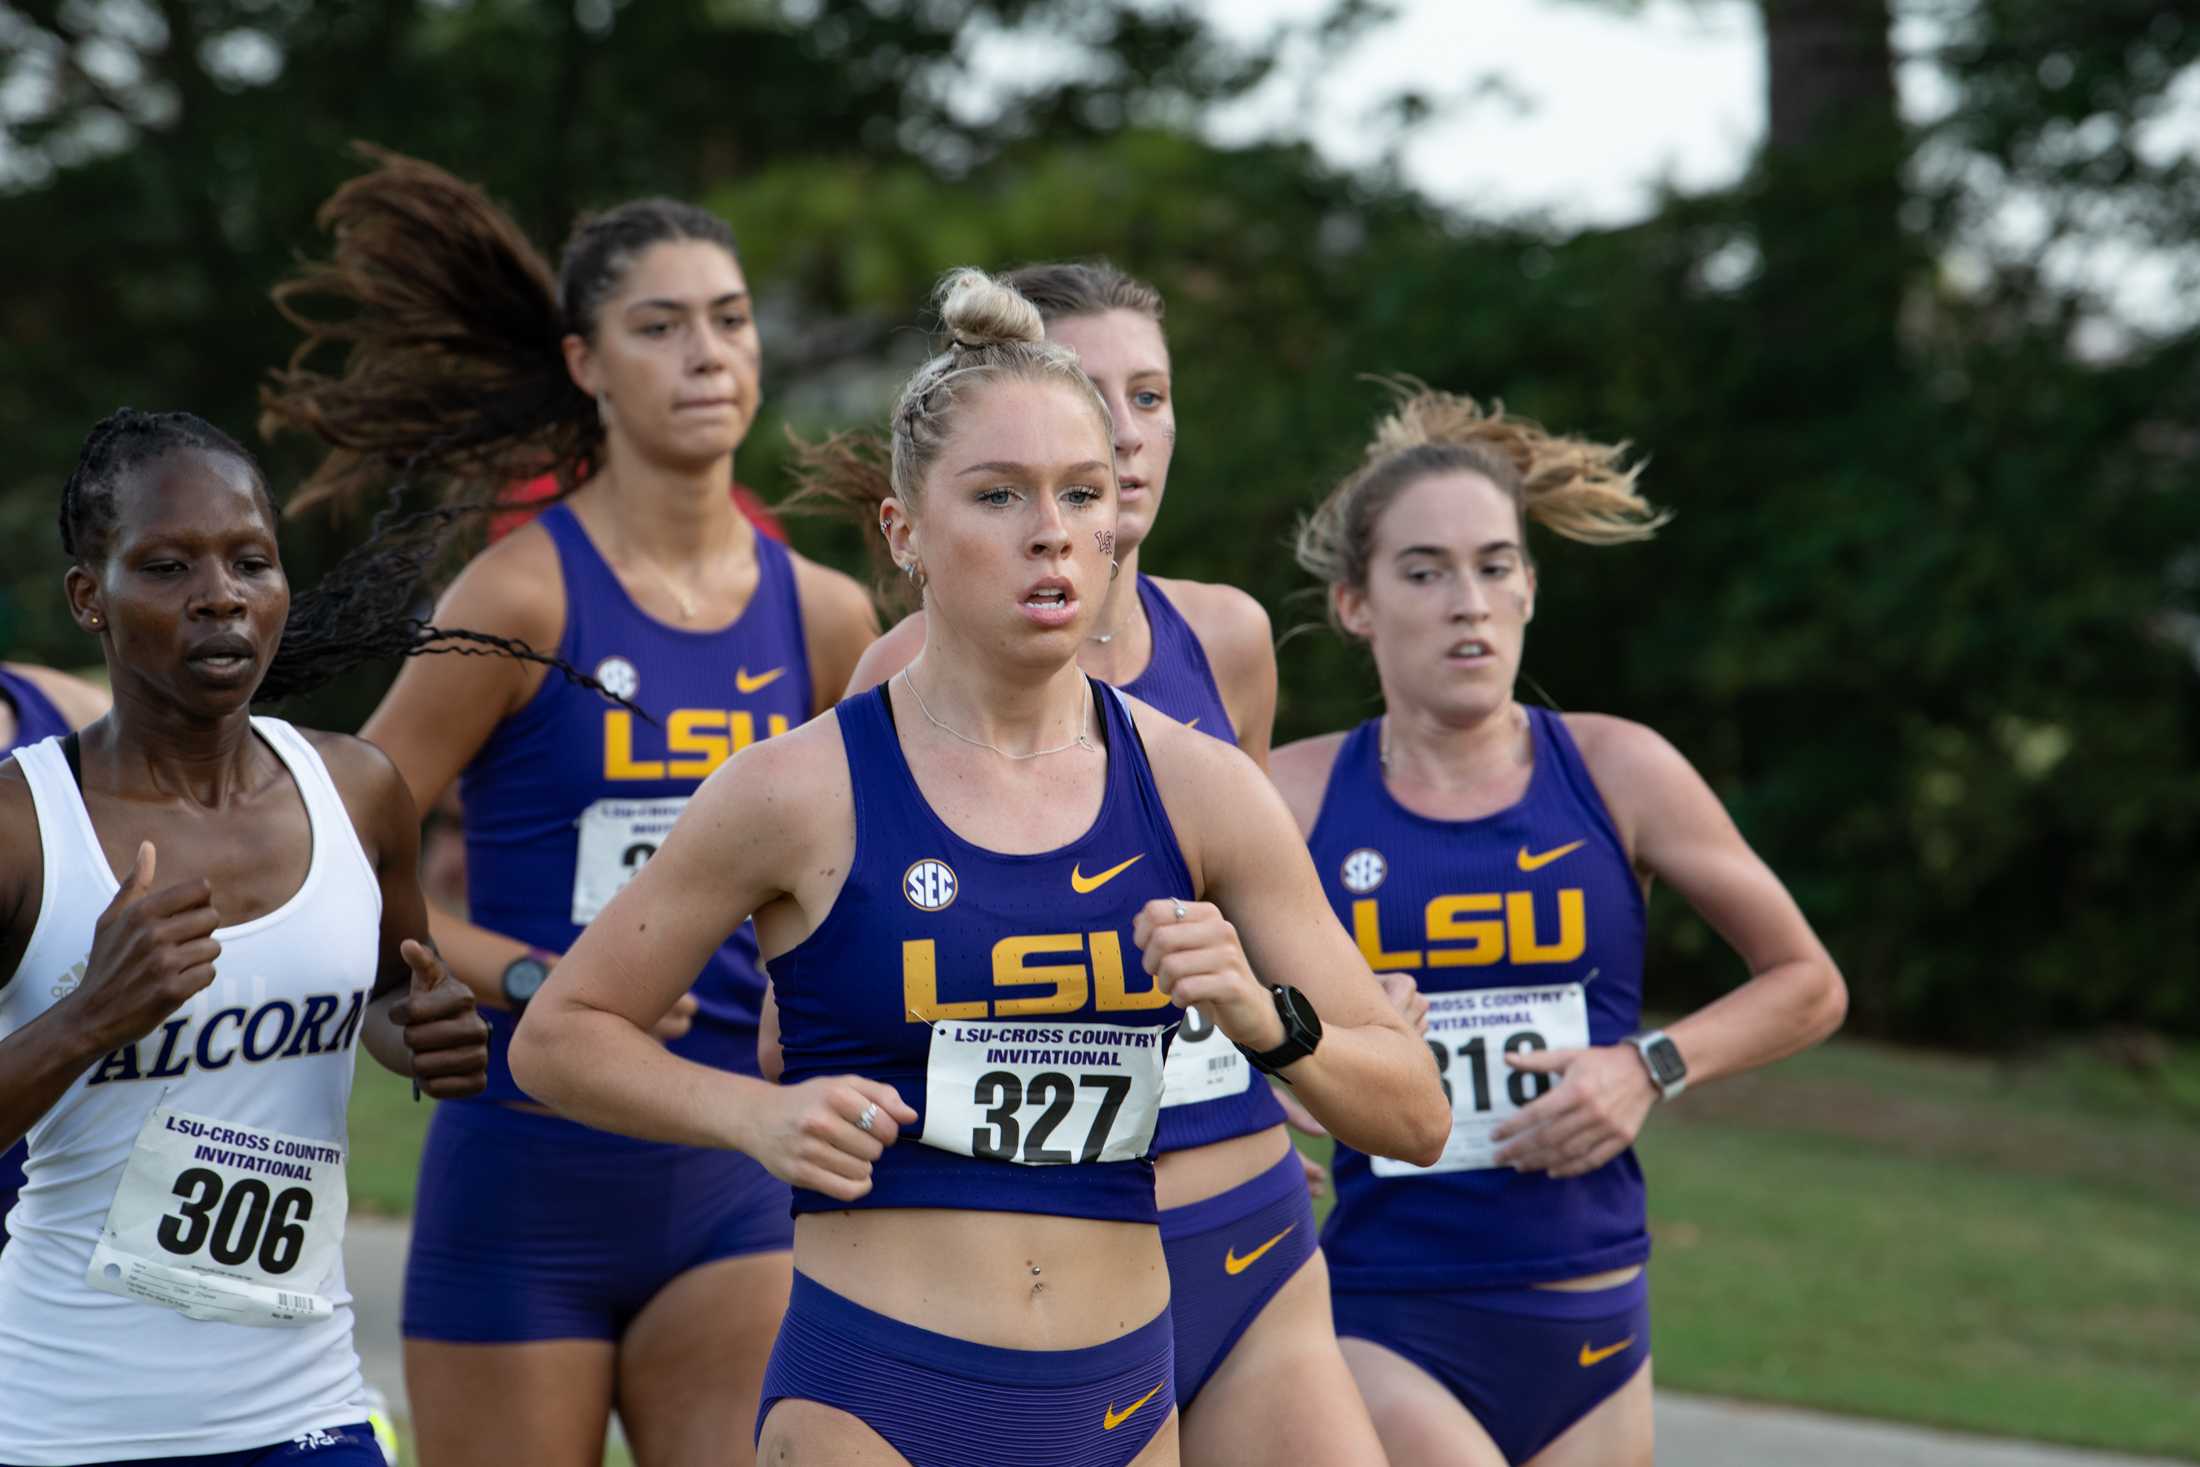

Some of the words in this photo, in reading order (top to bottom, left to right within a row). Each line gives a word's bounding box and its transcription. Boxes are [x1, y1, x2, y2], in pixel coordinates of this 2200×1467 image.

[907, 860, 954, 908] SEC
[1352, 888, 1587, 971] LSU
[1430, 1011, 1534, 1032] VITATIONAL
[1481, 991, 1563, 1009] COUNTRY
[954, 1027, 1064, 1043] LSU-CROSS
[1068, 1029, 1158, 1048] COUNTRY
[986, 1048, 1122, 1066] INVITATIONAL
[971, 1070, 1133, 1164] 327
[165, 1115, 270, 1151] LSU-CROSS
[273, 1139, 341, 1165] COUNTRY
[194, 1144, 313, 1182] INVITATIONAL
[156, 1167, 314, 1275] 306
